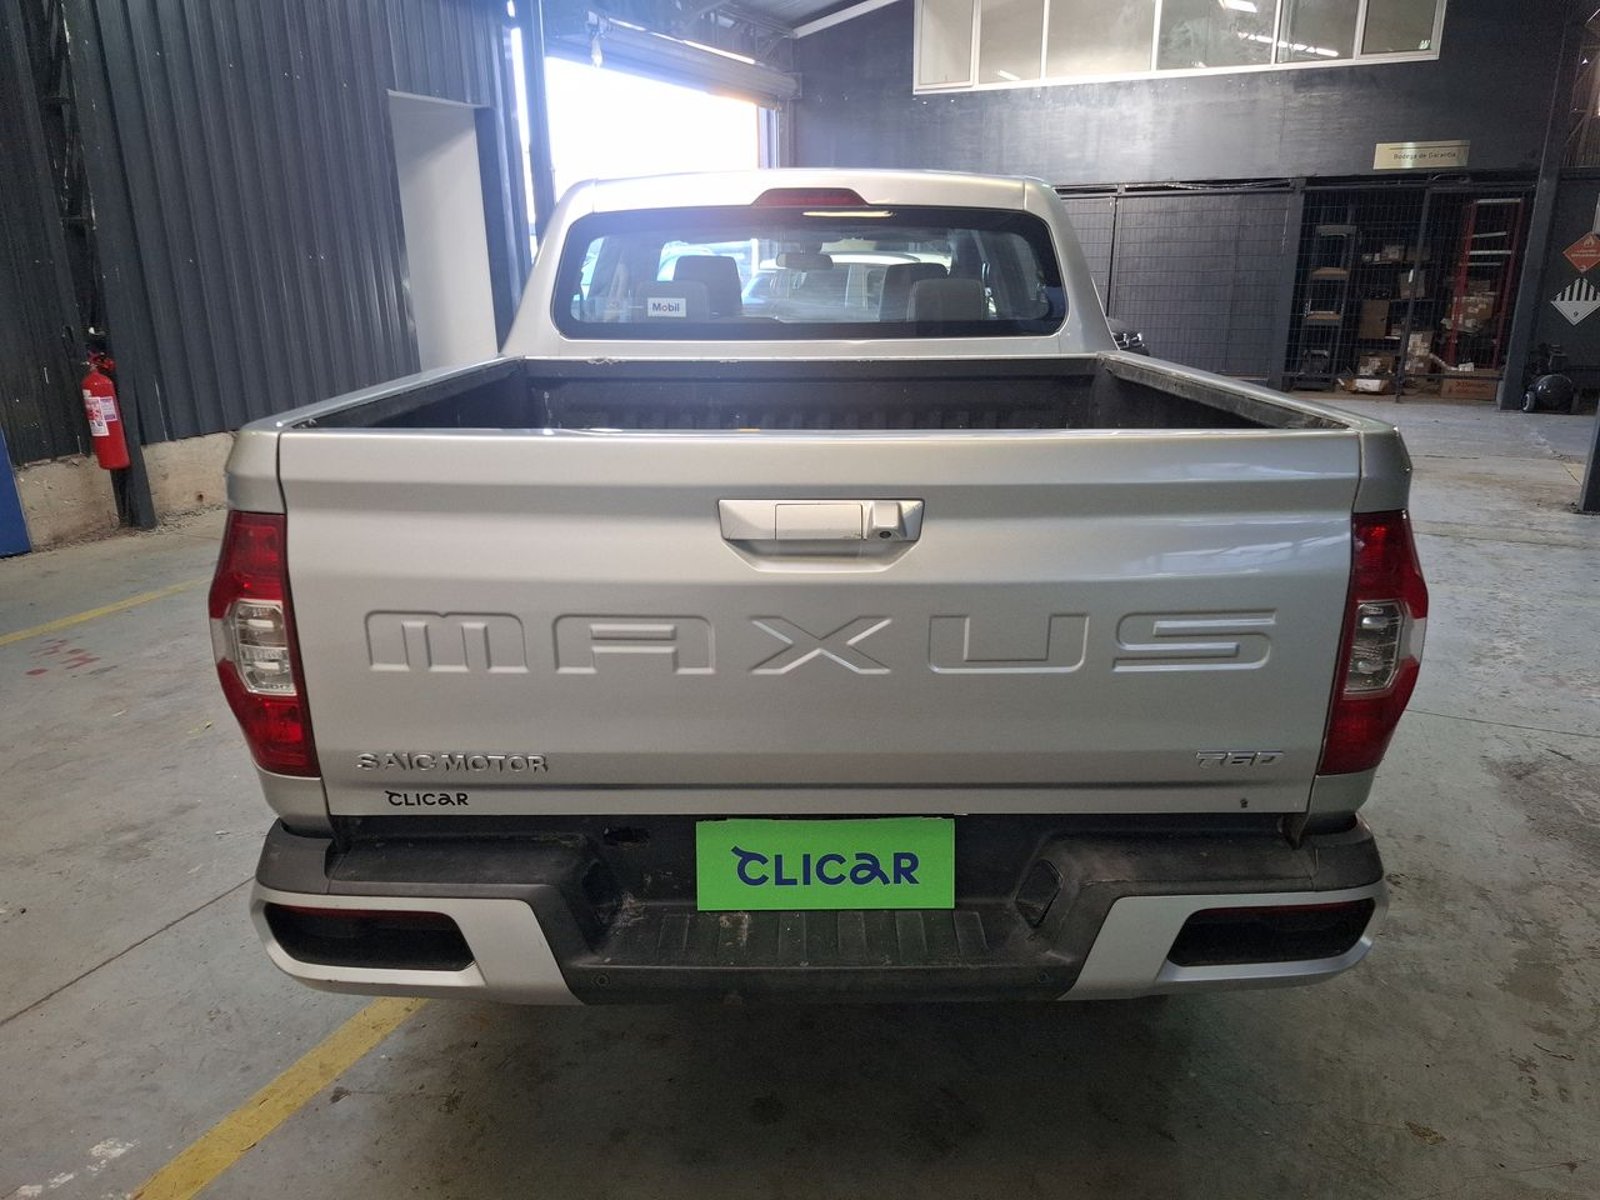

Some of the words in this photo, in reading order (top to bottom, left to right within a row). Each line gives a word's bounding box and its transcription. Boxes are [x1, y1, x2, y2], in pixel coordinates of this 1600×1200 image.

[652, 302, 680, 312] Mobil
[364, 607, 1278, 676] MAXUS
[356, 752, 437, 771] SAIC
[440, 753, 550, 773] MOTOR
